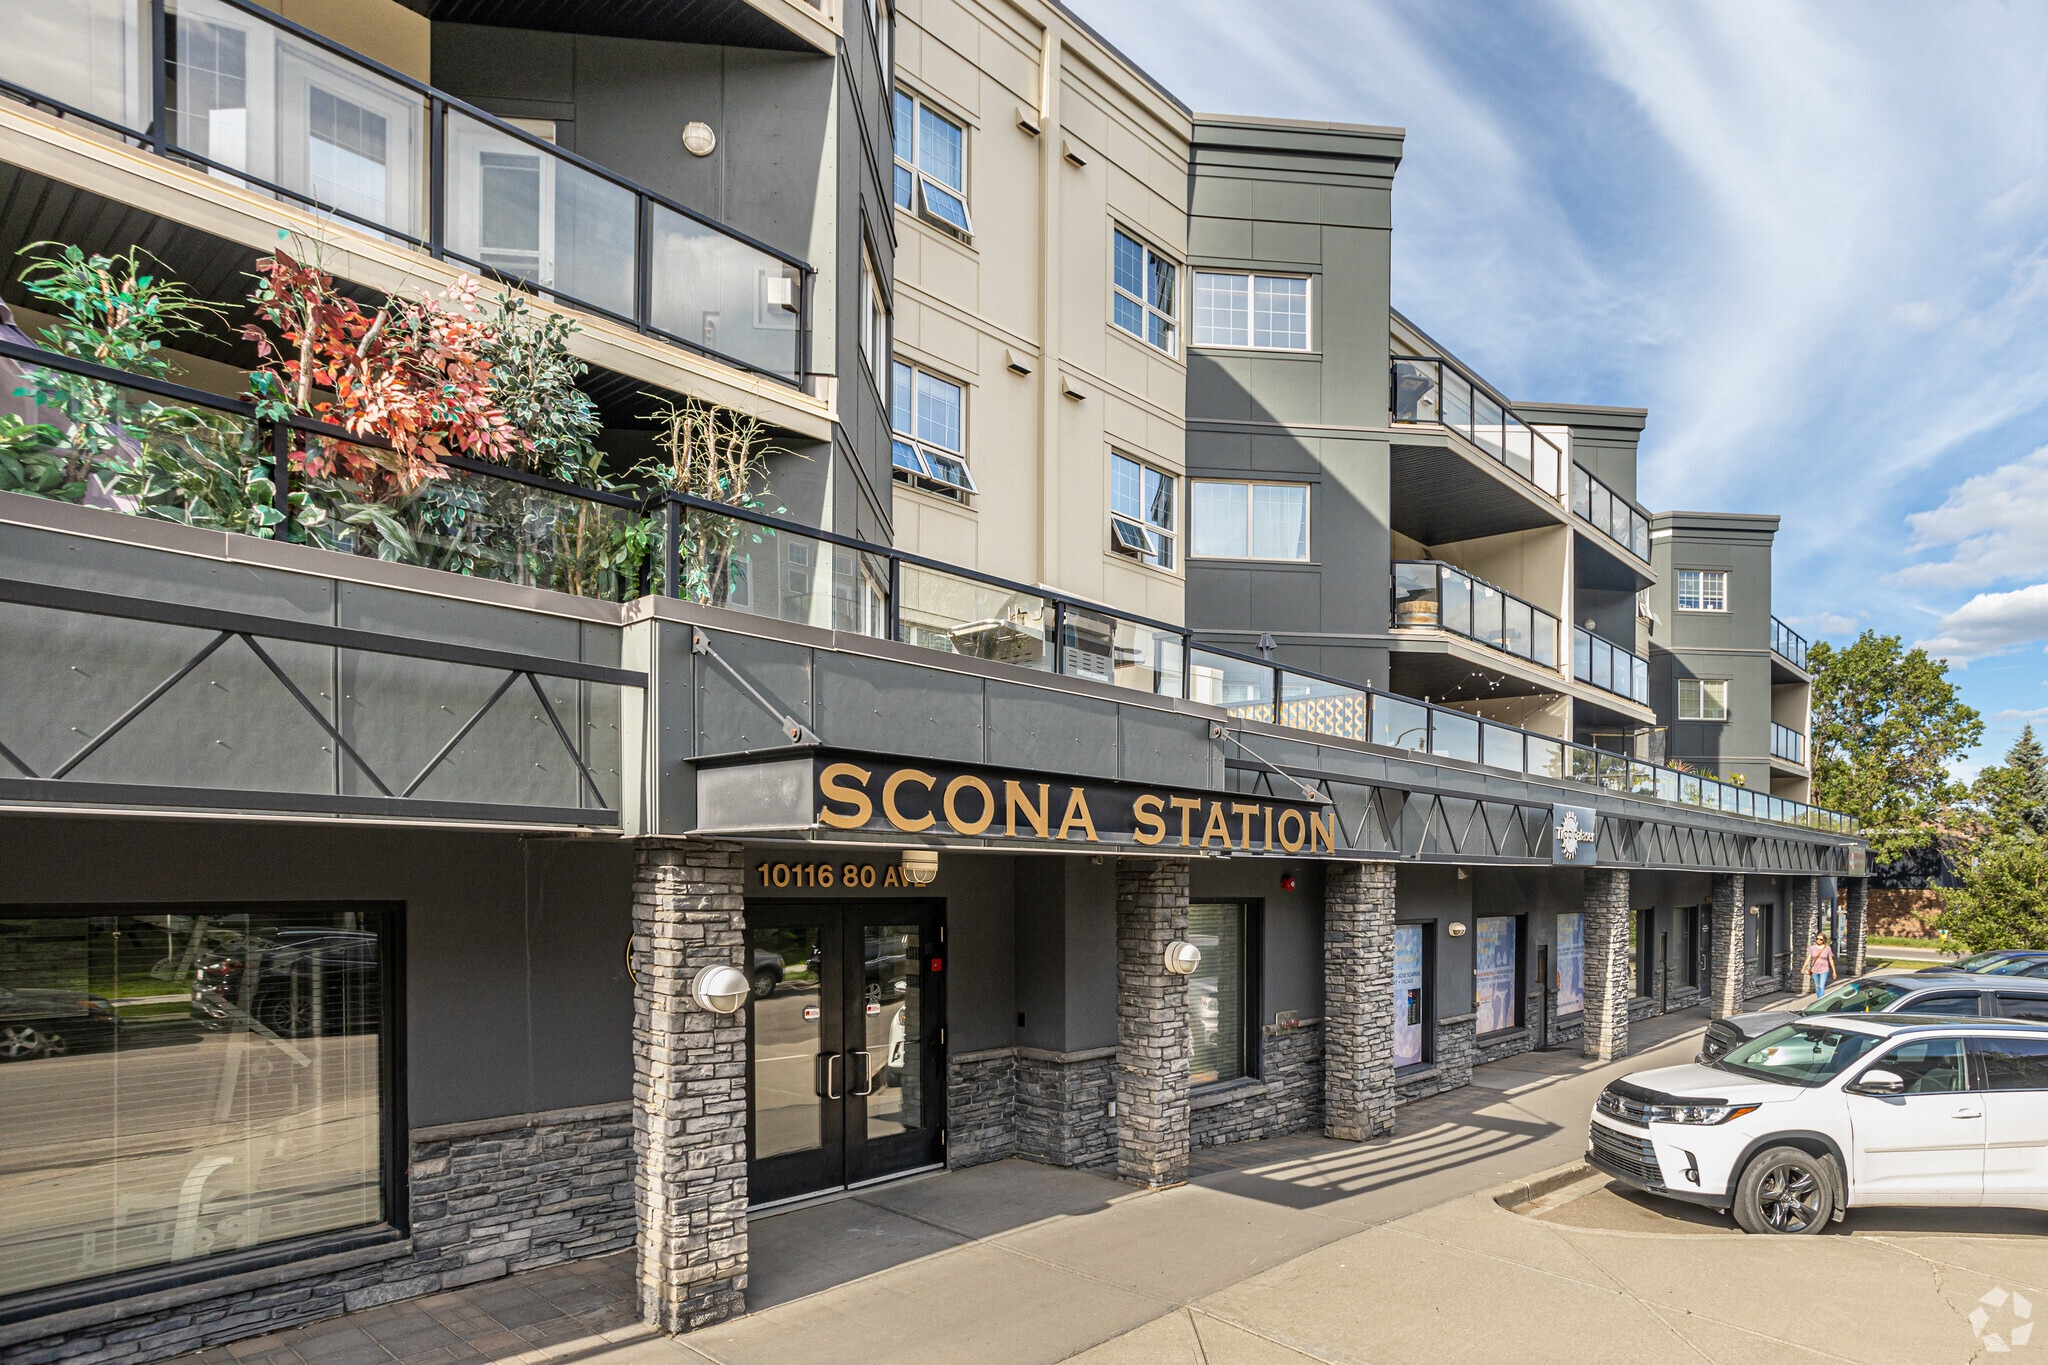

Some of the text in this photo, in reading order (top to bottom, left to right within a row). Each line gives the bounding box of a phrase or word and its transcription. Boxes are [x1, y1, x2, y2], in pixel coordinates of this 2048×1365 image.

[820, 763, 1335, 854] SCONA STATION
[758, 863, 834, 888] 10116
[843, 865, 876, 888] 80
